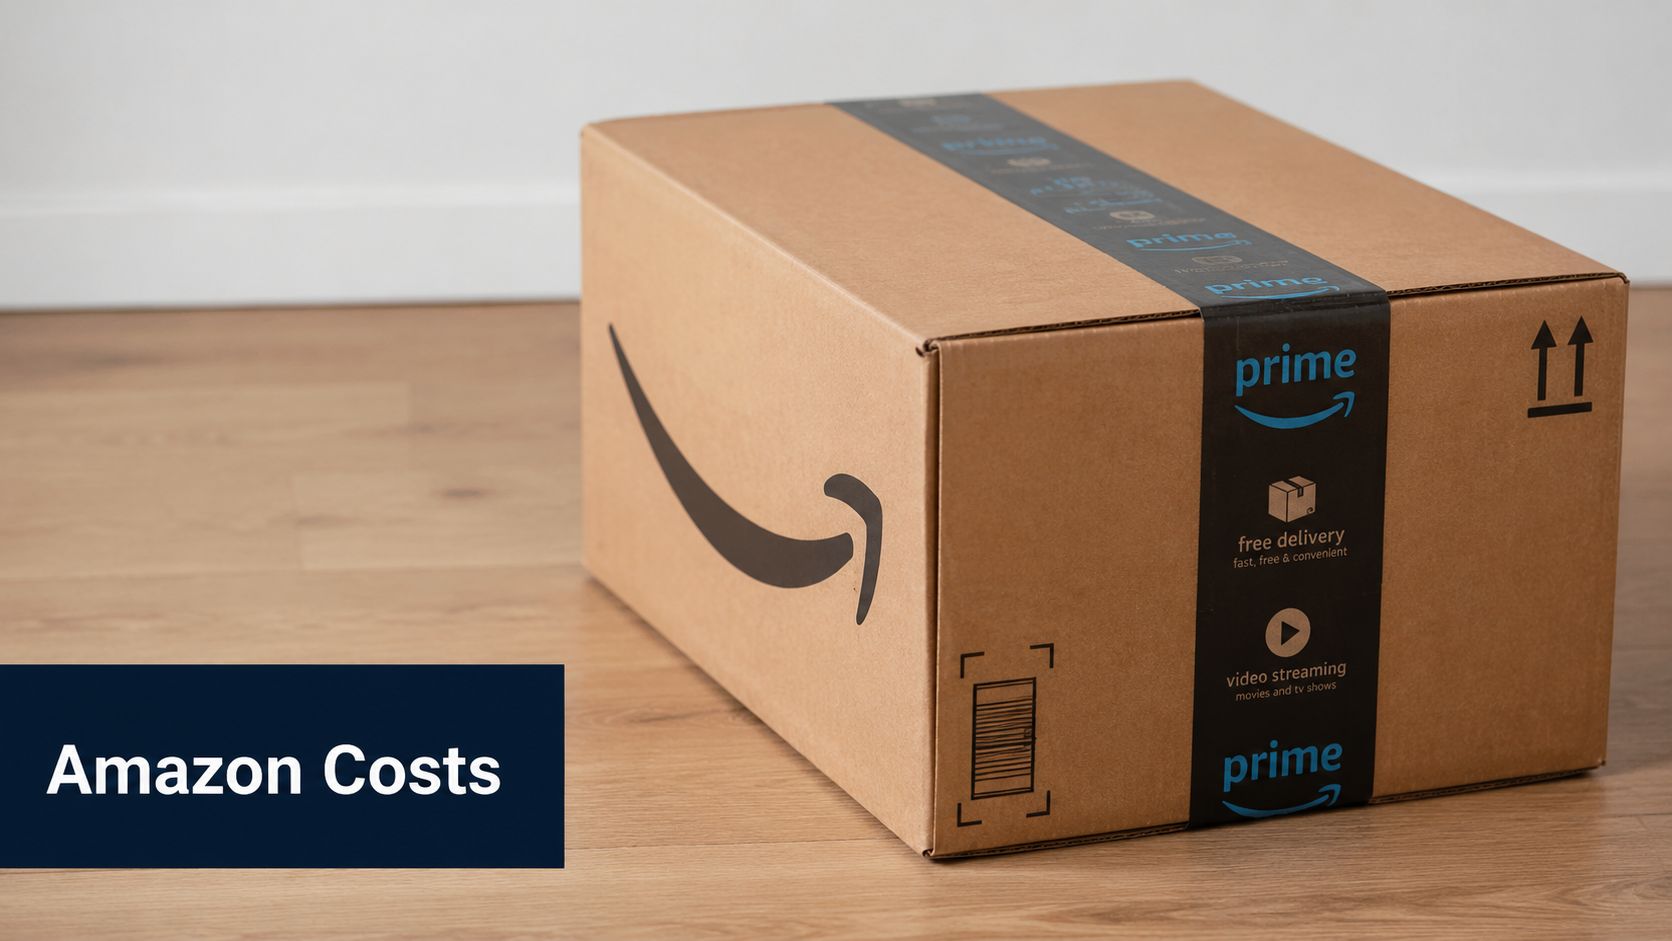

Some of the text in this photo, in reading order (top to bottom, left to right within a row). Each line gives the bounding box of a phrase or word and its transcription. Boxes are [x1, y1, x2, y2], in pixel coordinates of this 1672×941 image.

[1126, 232, 1237, 249] prime
[1205, 277, 1328, 295] prime
[1235, 342, 1357, 398] prime
[1238, 529, 1345, 553] free delivery
[1233, 547, 1348, 569] fast, free & convenient
[1226, 662, 1347, 688] video streaming
[1235, 681, 1337, 702] movies and tv shows
[1223, 739, 1343, 793] prime
